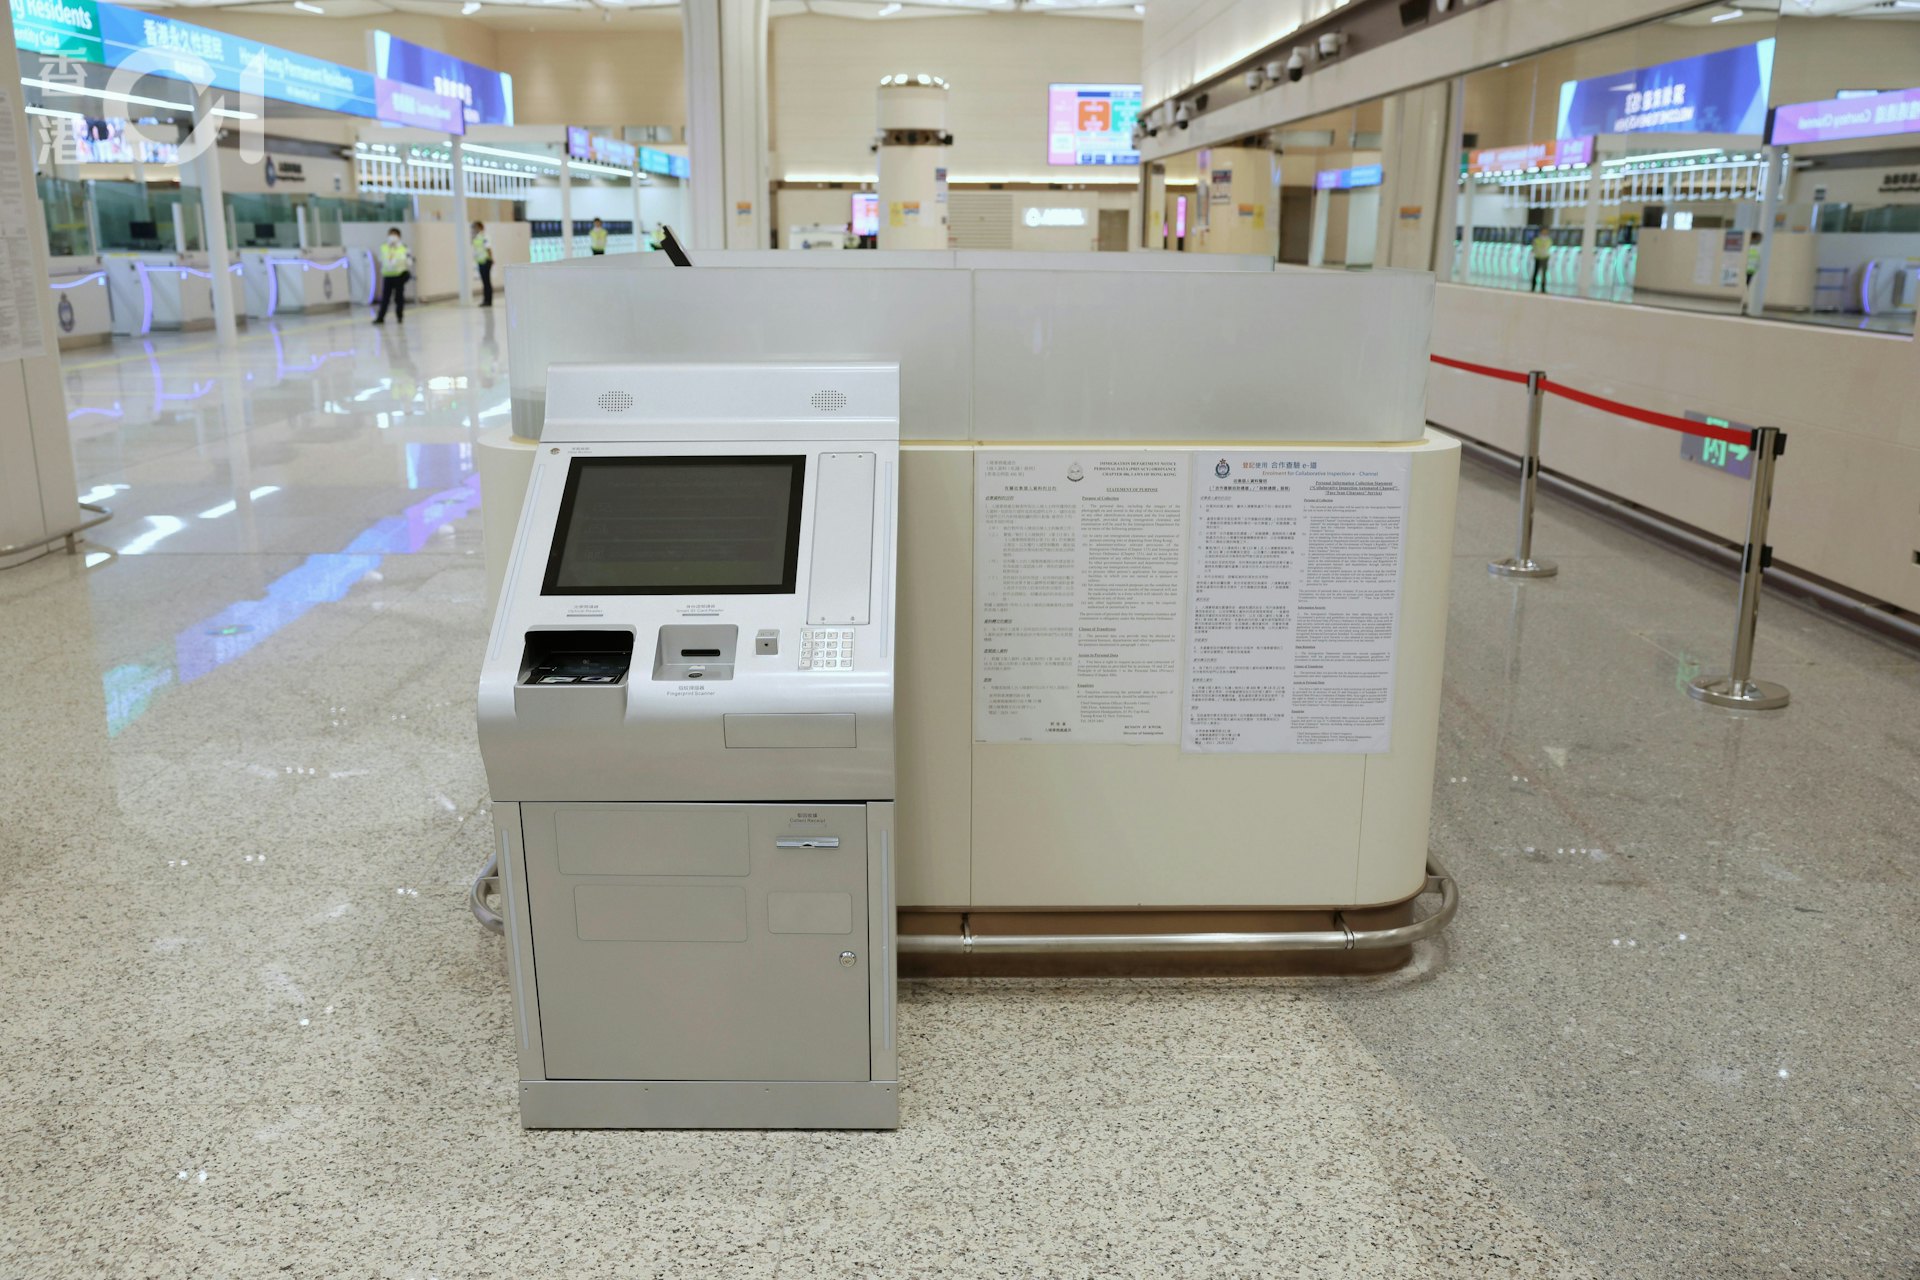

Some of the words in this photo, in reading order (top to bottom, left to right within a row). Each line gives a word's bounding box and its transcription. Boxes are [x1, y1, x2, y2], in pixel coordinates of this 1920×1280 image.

[1271, 461, 1301, 469] 合作查驗
[1302, 461, 1317, 469] e-道
